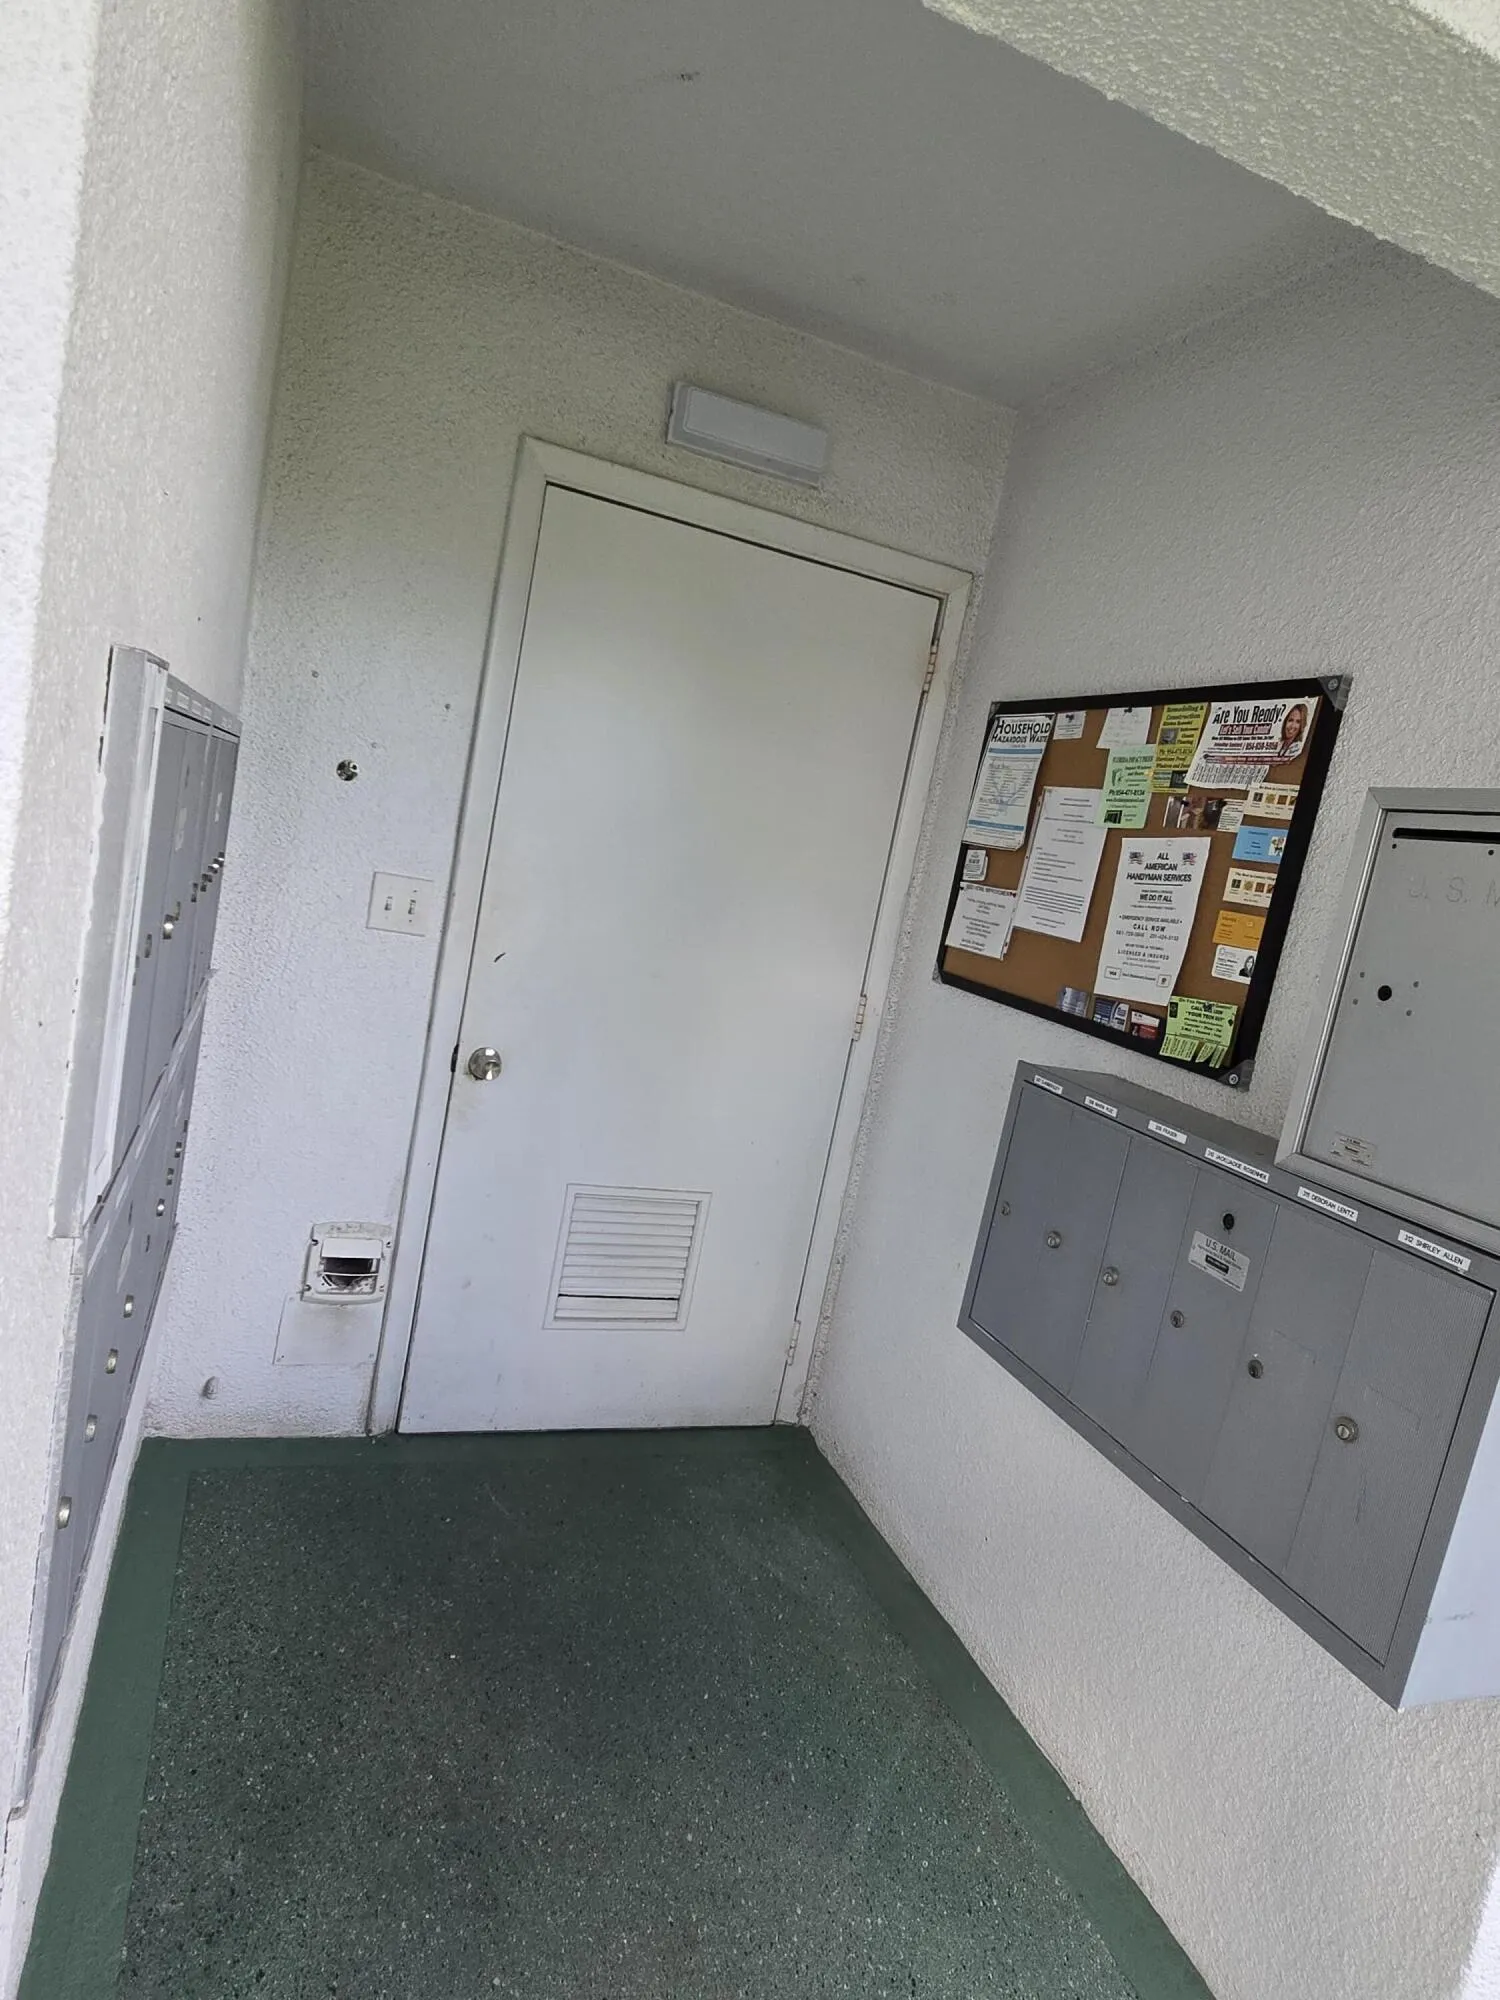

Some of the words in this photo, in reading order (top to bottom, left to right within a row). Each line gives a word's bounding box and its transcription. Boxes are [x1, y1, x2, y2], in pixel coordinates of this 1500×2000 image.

[1212, 707, 1230, 724] Are
[1233, 706, 1250, 723] You
[1251, 704, 1287, 724] Ready?
[995, 720, 1052, 734] HOUSEHOLD
[991, 734, 1028, 743] HAZARDOUS
[1157, 852, 1170, 860] ALL
[1144, 863, 1178, 871] AMERICAN
[1126, 872, 1162, 881] HANDYMAN
[1163, 873, 1192, 882] SERVICES
[1133, 923, 1148, 931] CALL
[1117, 949, 1141, 957] LICENSED
[1311, 1194, 1337, 1211] DEBORAH
[1337, 1204, 1355, 1218] LENTZ
[1219, 1245, 1237, 1262] MAIL
[1404, 1233, 1414, 1243] 312
[1416, 1239, 1441, 1255] SHIRLEY
[1443, 1251, 1464, 1266] ALLEN
